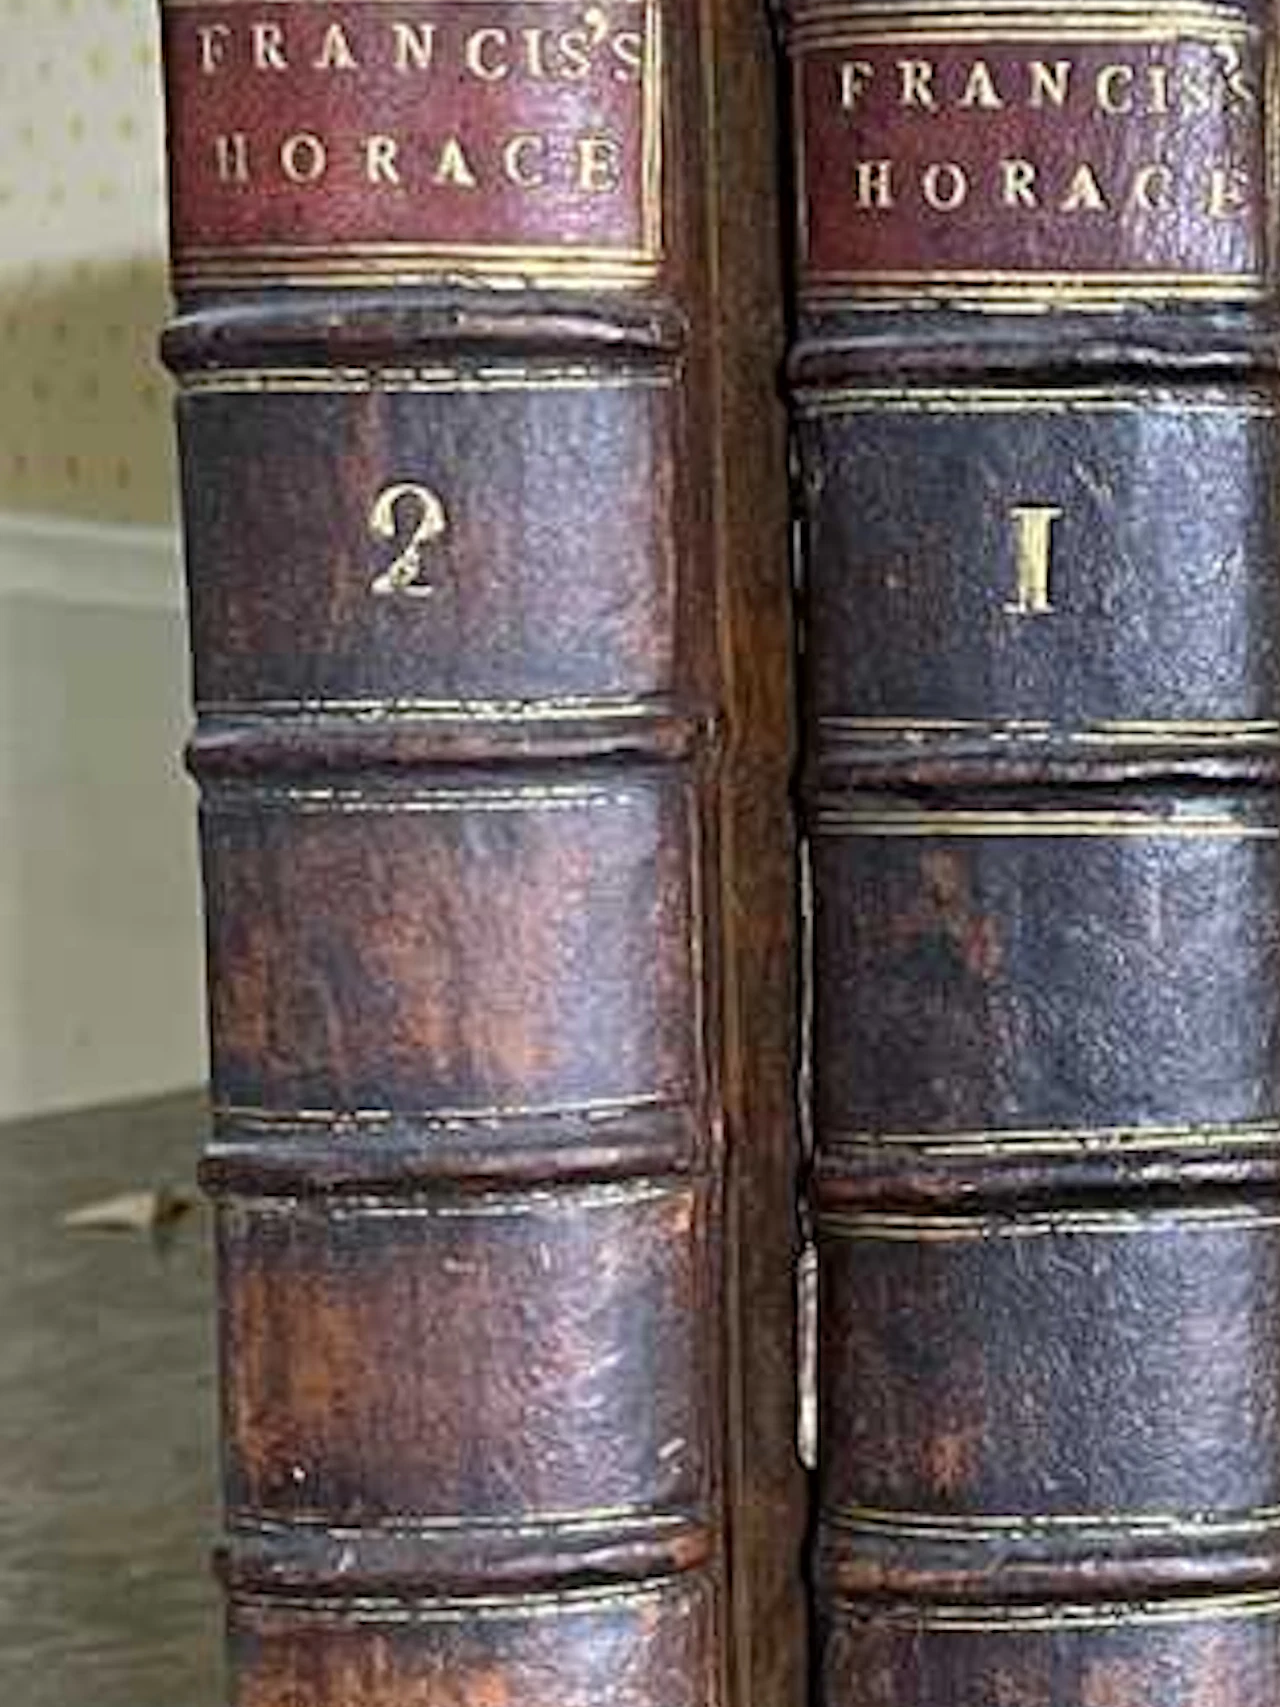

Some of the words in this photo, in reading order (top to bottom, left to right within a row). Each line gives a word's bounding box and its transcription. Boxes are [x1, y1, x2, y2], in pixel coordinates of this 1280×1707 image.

[214, 132, 624, 192] HORACE
[855, 159, 1248, 218] HORACE
[368, 481, 447, 593] 2
